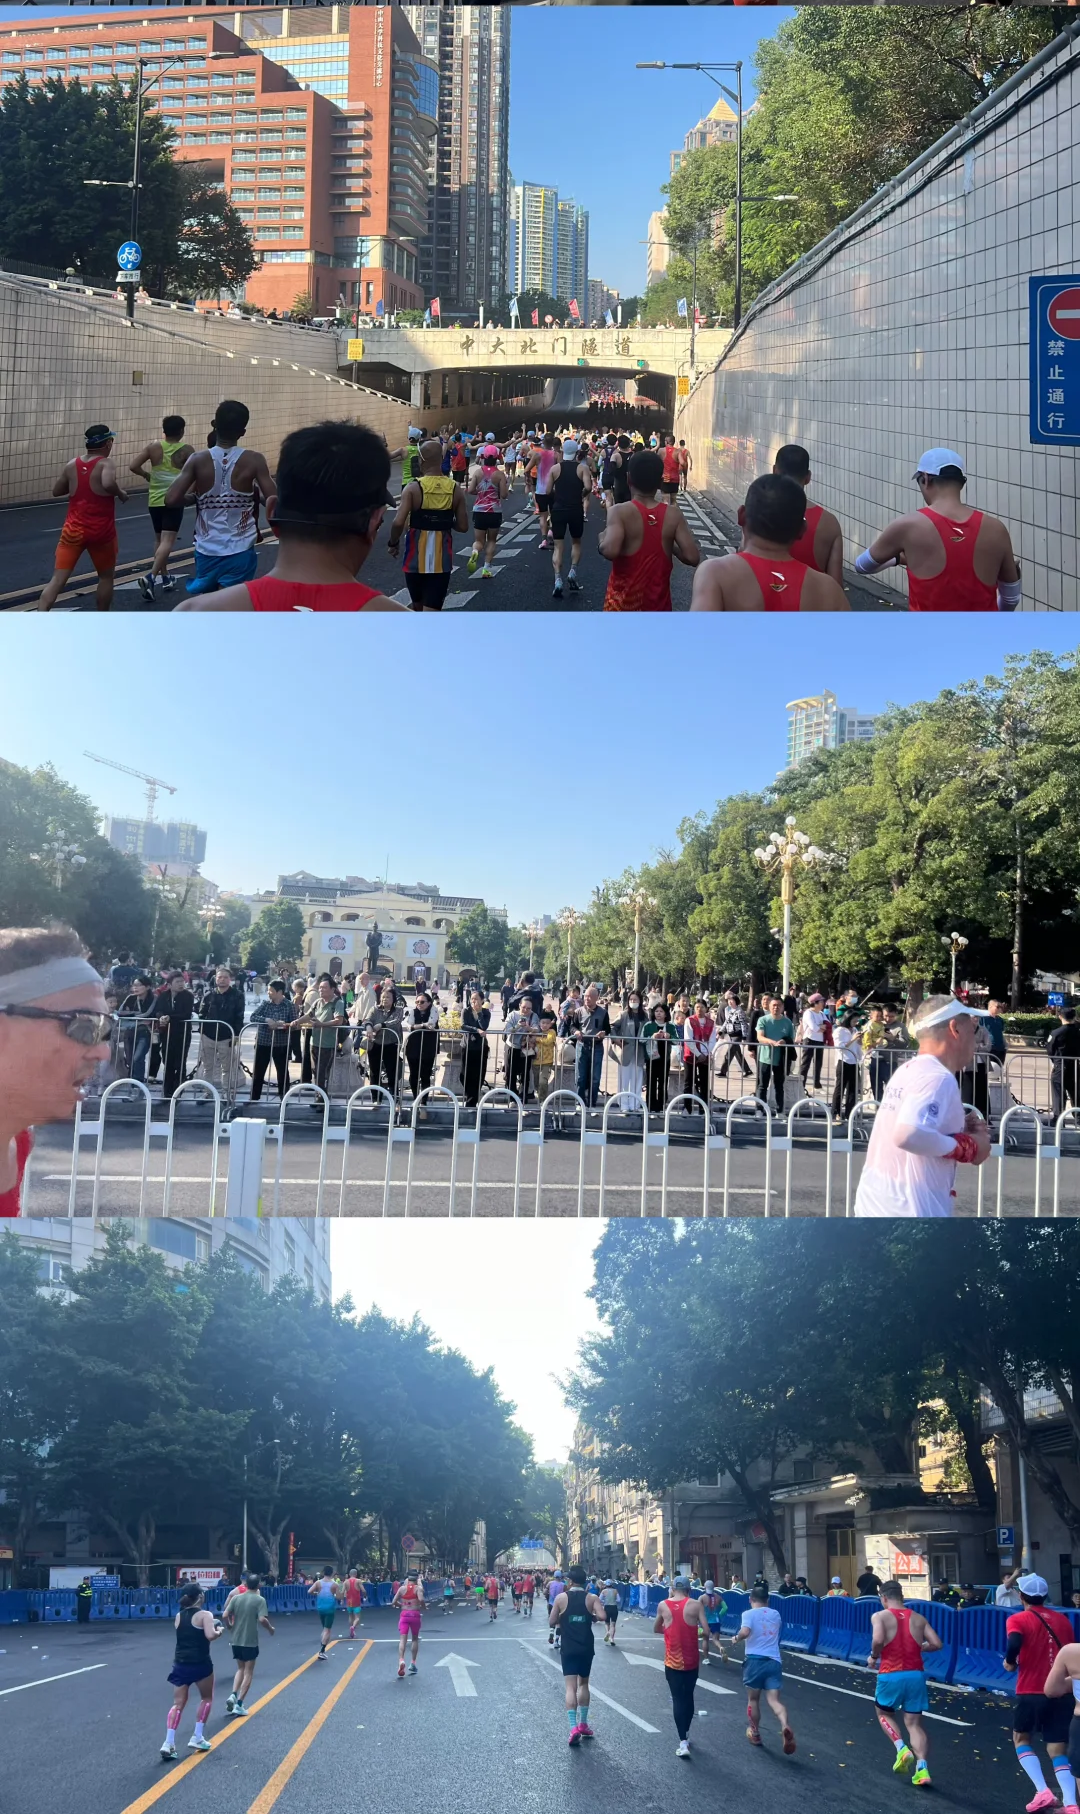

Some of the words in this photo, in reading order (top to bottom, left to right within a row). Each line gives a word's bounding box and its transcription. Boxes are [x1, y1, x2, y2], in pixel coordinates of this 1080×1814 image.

[460, 334, 635, 358] 中大北门隧道
[1047, 339, 1065, 429] 禁止通行
[1000, 1529, 1009, 1543] P
[898, 1554, 920, 1571] 公寓
